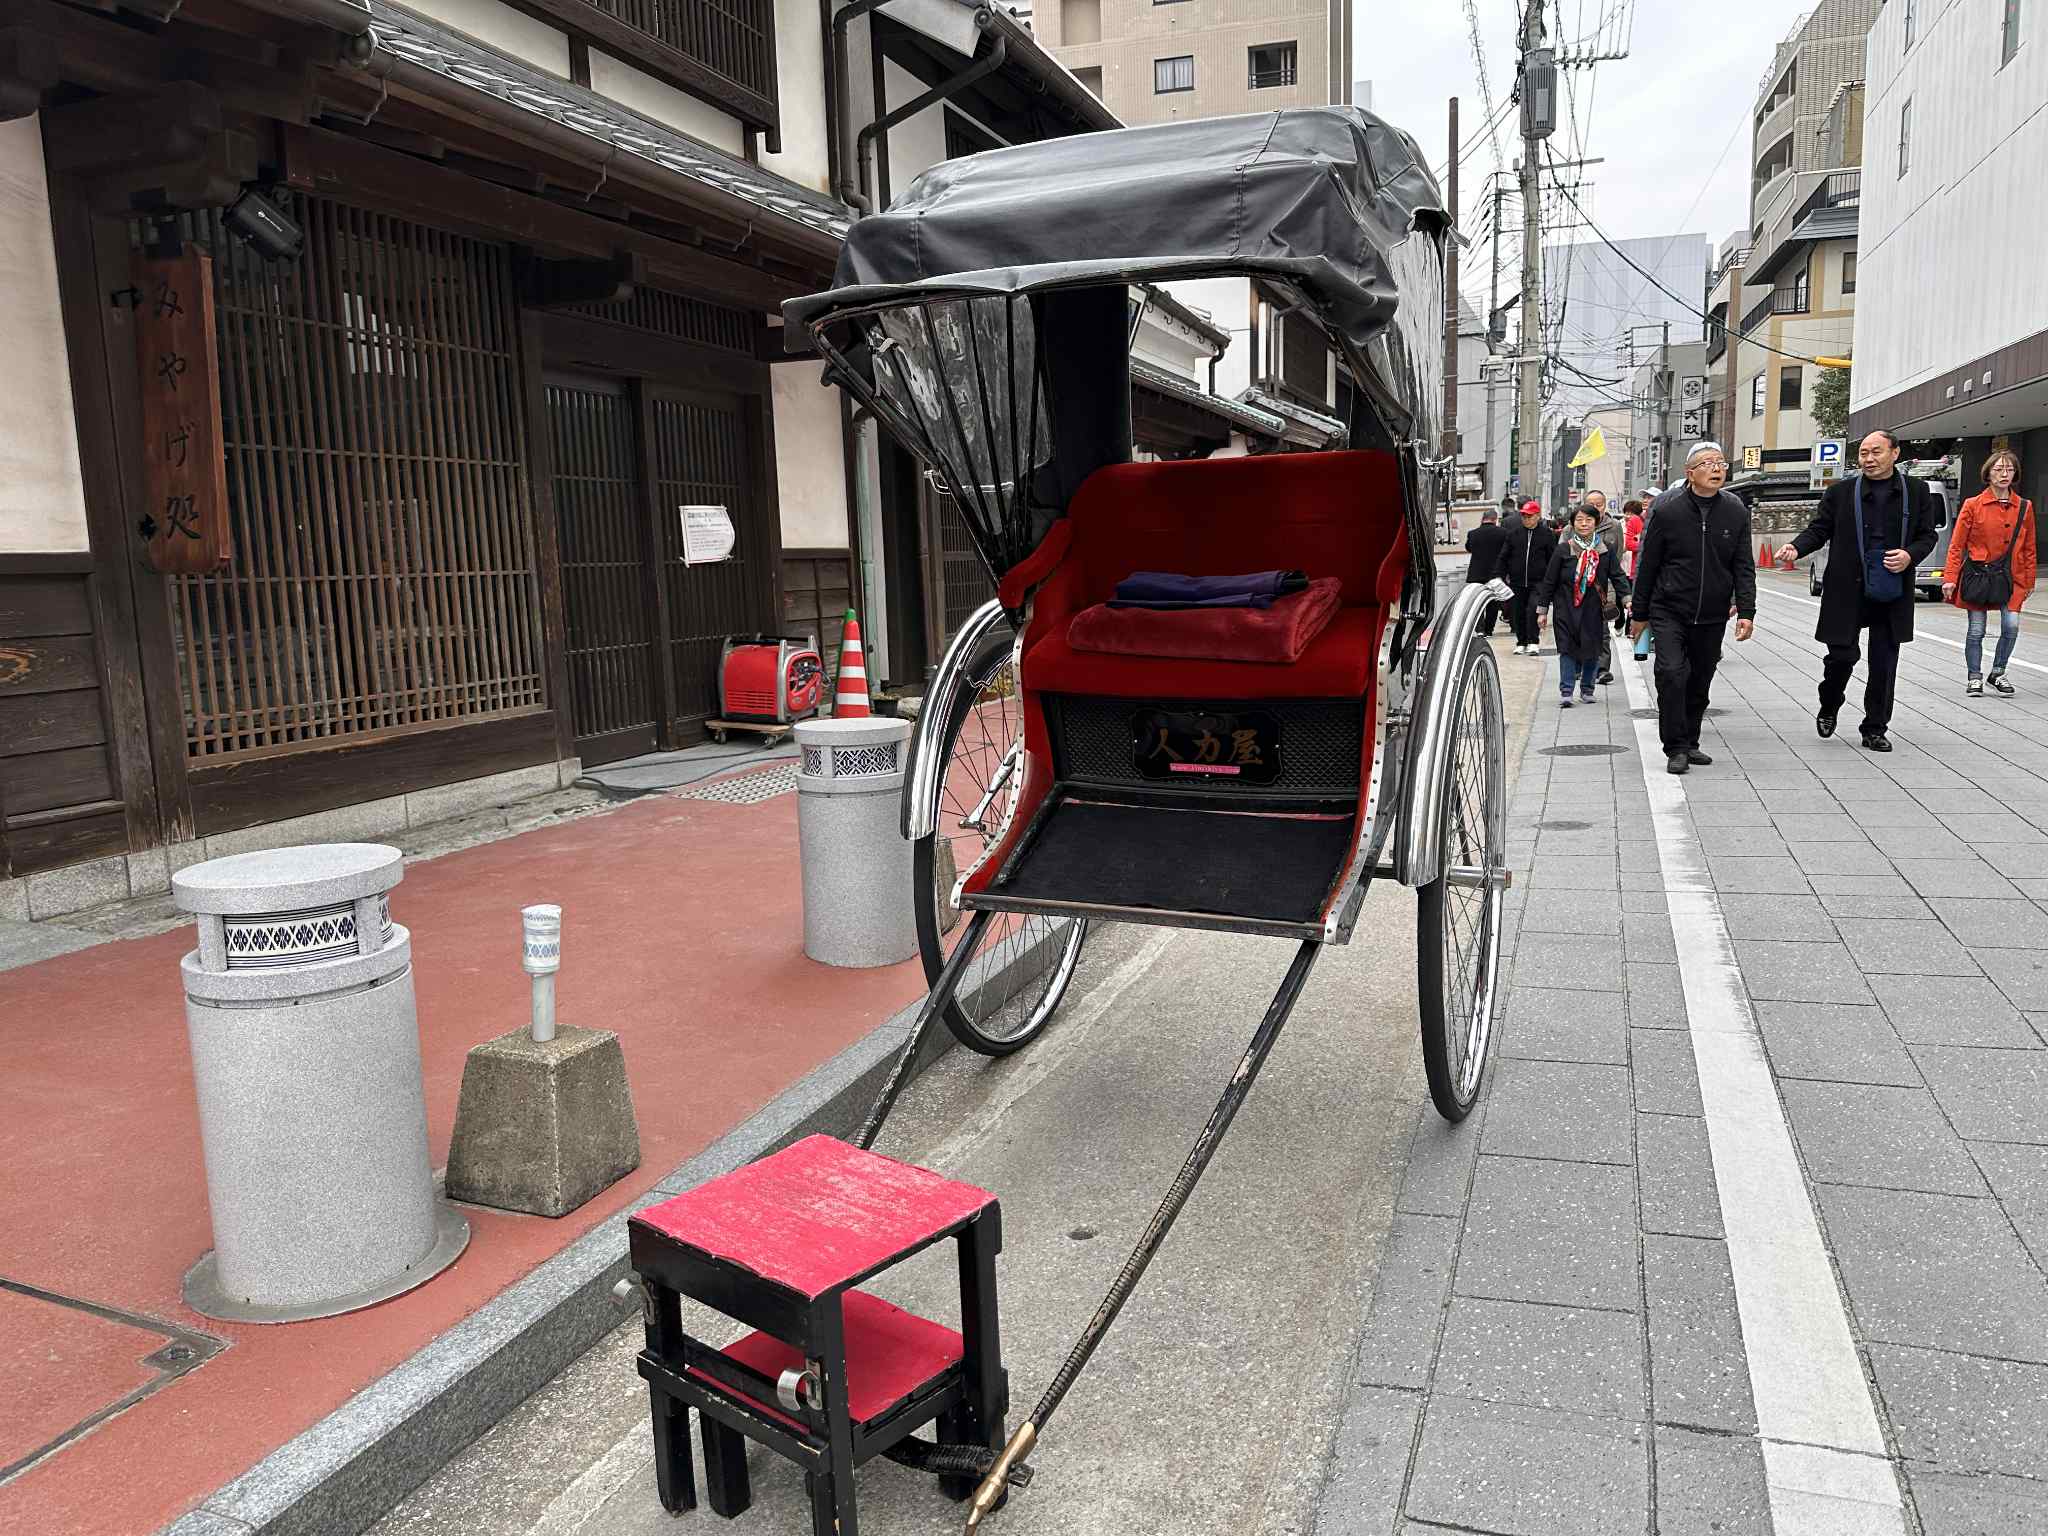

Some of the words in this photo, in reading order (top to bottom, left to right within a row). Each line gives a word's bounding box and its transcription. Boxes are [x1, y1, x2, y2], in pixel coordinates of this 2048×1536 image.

[153, 280, 201, 540] みやげ処
[1820, 443, 1839, 461] P
[1149, 727, 1264, 765] 人力屋
